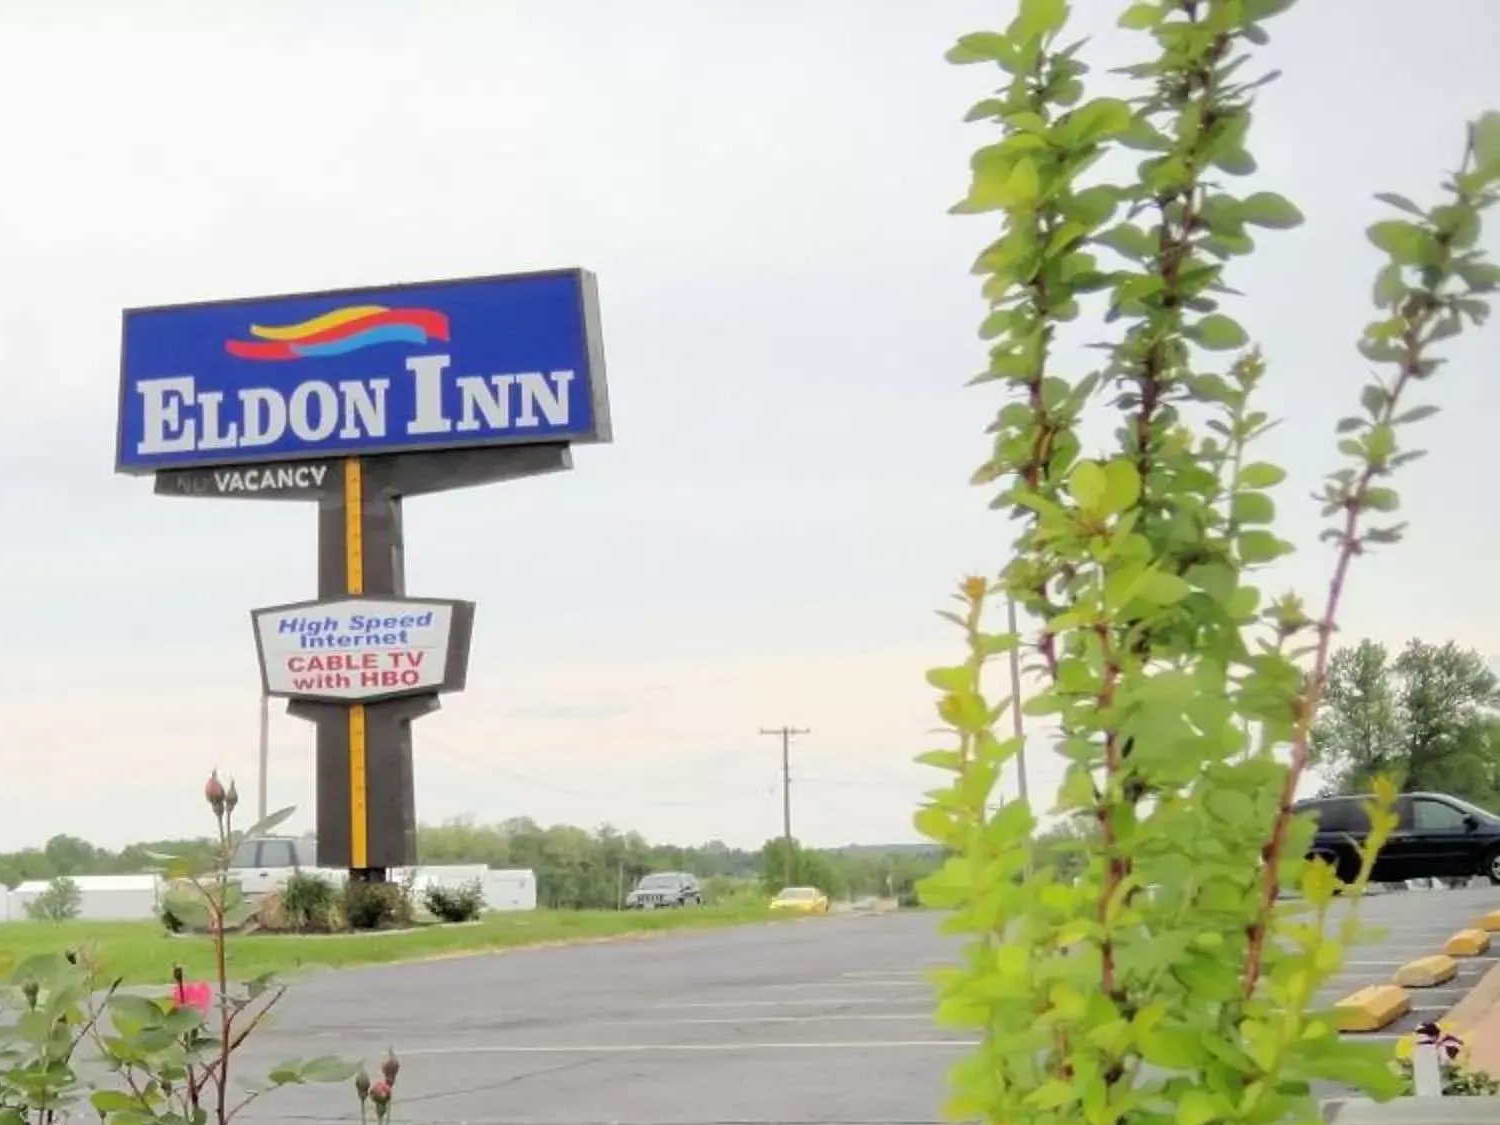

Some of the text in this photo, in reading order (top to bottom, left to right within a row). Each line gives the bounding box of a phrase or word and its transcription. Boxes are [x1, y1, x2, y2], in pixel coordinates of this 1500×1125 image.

[136, 354, 575, 455] ELDON INN
[214, 465, 327, 493] VACANCY
[278, 612, 433, 635] High Speed
[300, 630, 408, 649] Internet
[287, 651, 424, 673] CABLE TV
[292, 669, 420, 690] with HBO
